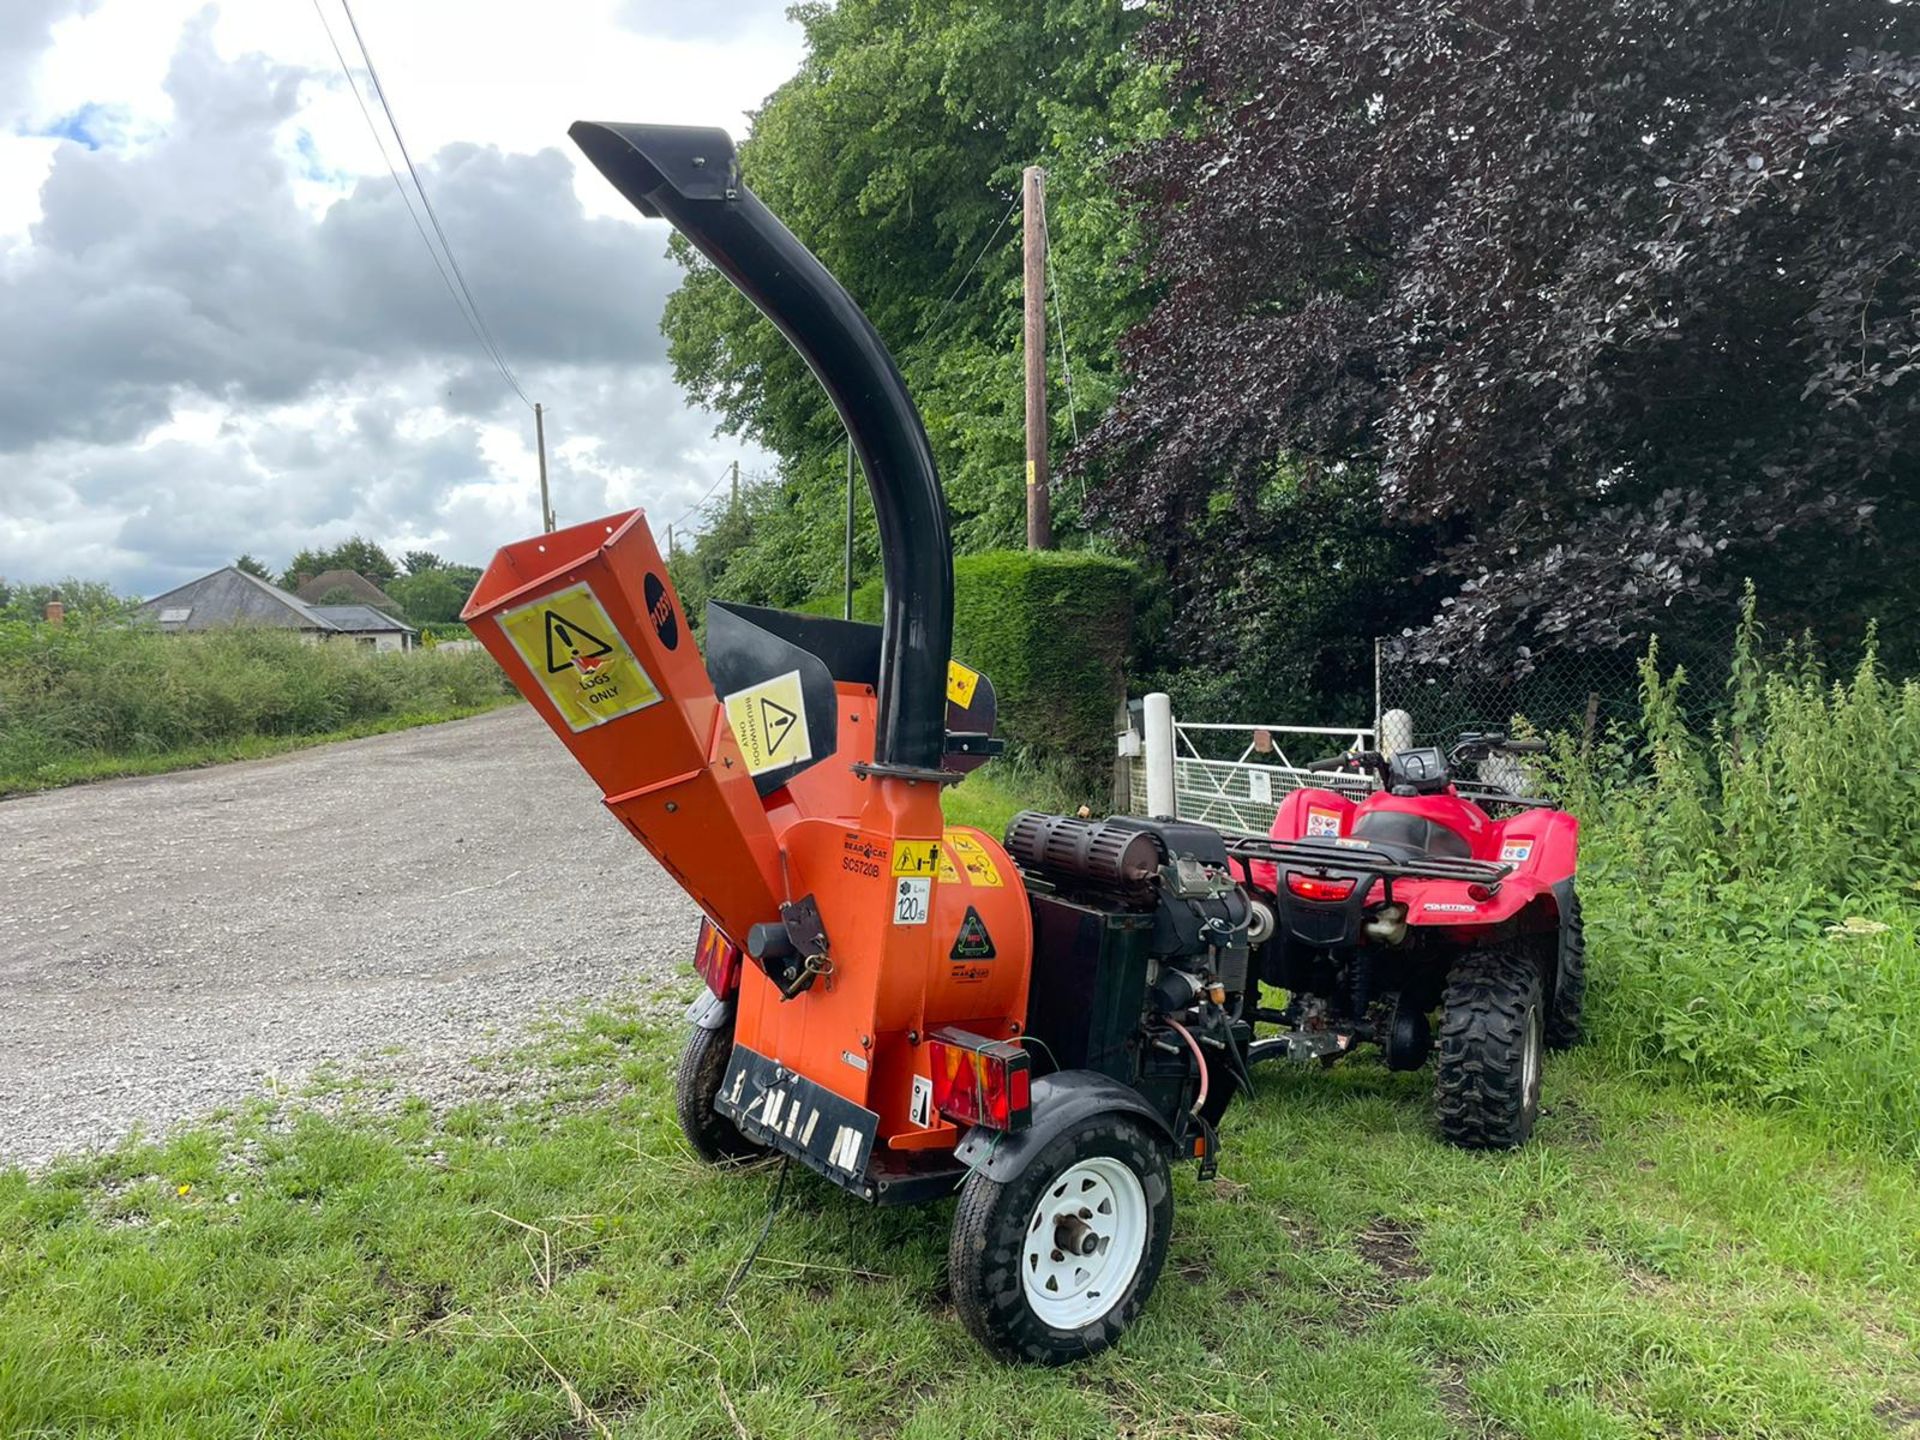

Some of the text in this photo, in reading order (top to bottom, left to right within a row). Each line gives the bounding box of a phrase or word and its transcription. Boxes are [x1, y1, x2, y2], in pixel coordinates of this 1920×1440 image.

[579, 672, 610, 690] LOGS
[589, 686, 618, 704] ONLY
[739, 721, 748, 747] ONLY
[745, 697, 760, 766] BRUSHWOOD
[844, 842, 887, 858] BEAR CAT
[842, 856, 880, 878] SC5720B
[898, 897, 918, 920] 120
